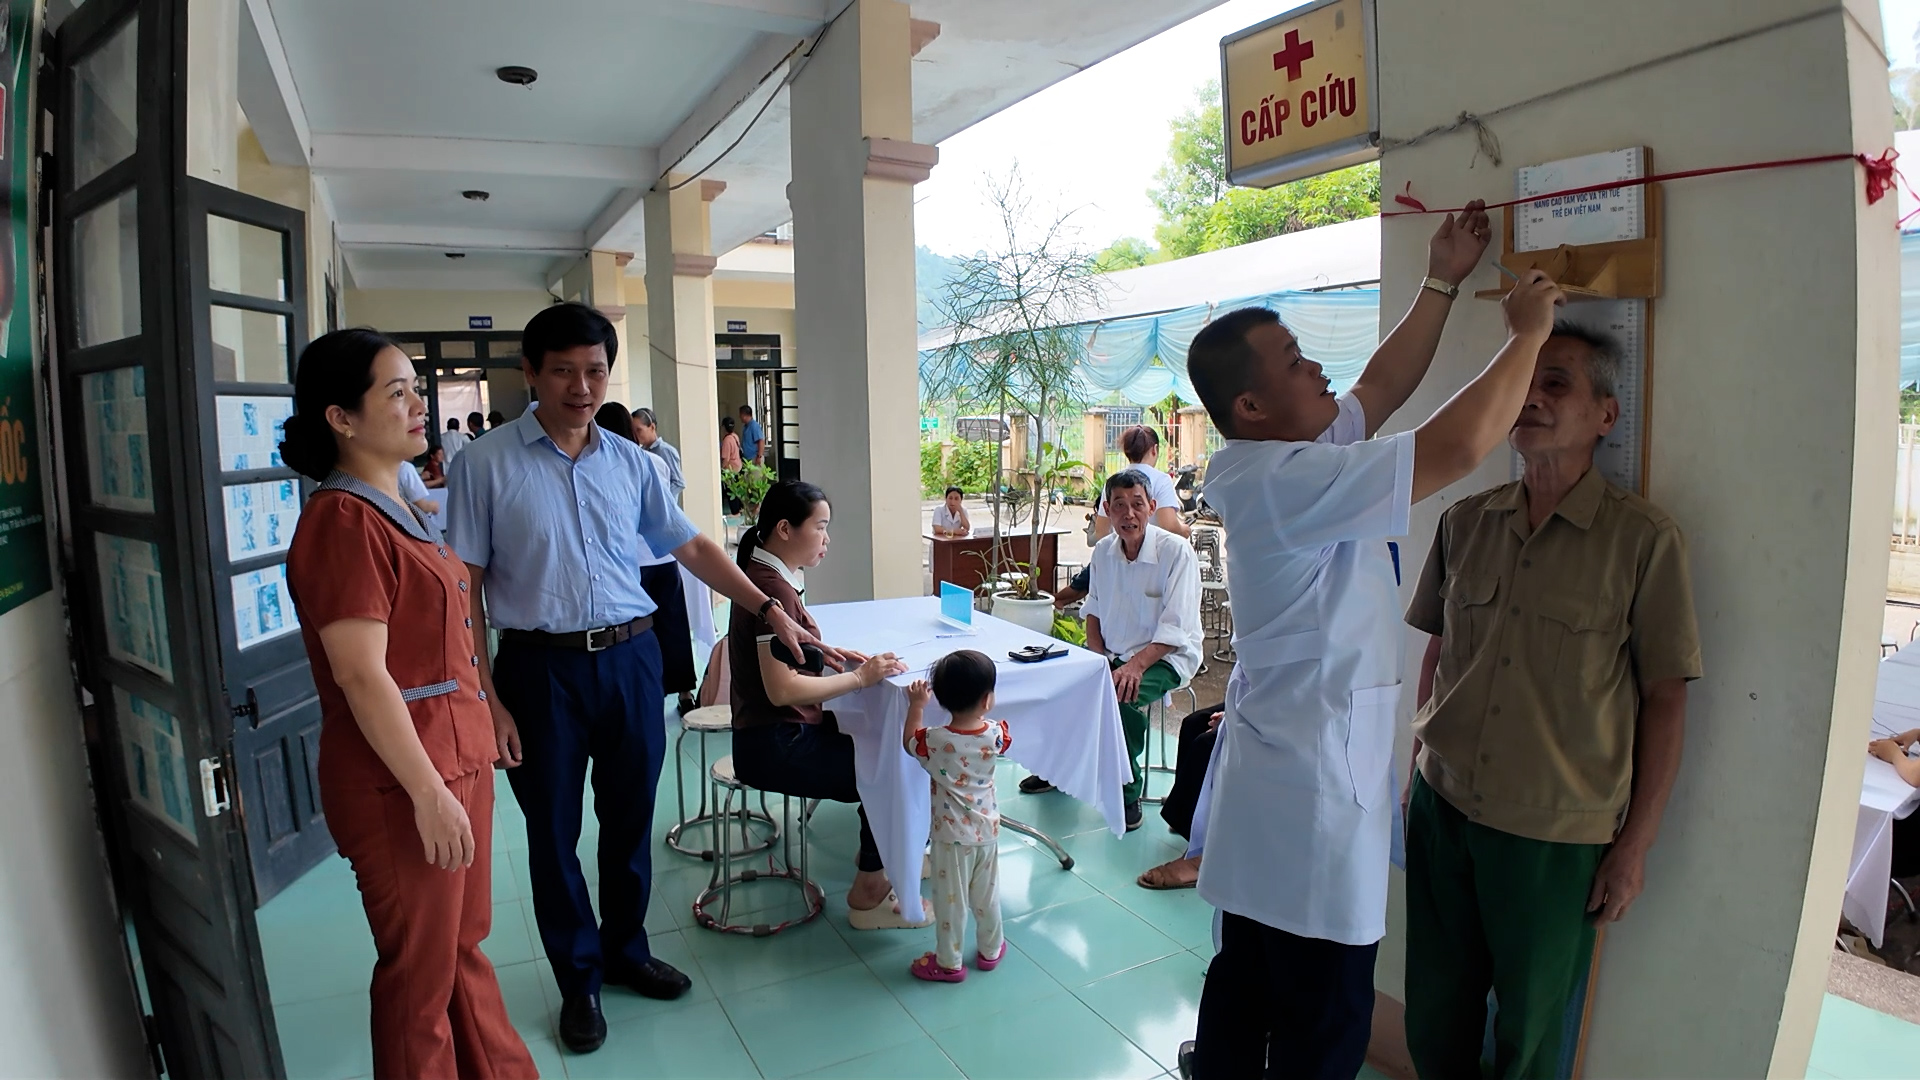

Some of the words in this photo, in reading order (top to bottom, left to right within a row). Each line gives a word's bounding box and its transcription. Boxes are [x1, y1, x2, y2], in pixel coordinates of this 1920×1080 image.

[1241, 94, 1291, 146] CẤP
[1301, 73, 1357, 128] CỨU
[1564, 207, 1573, 217] EM
[1574, 204, 1587, 217] VIỆT
[1587, 204, 1601, 213] NAM
